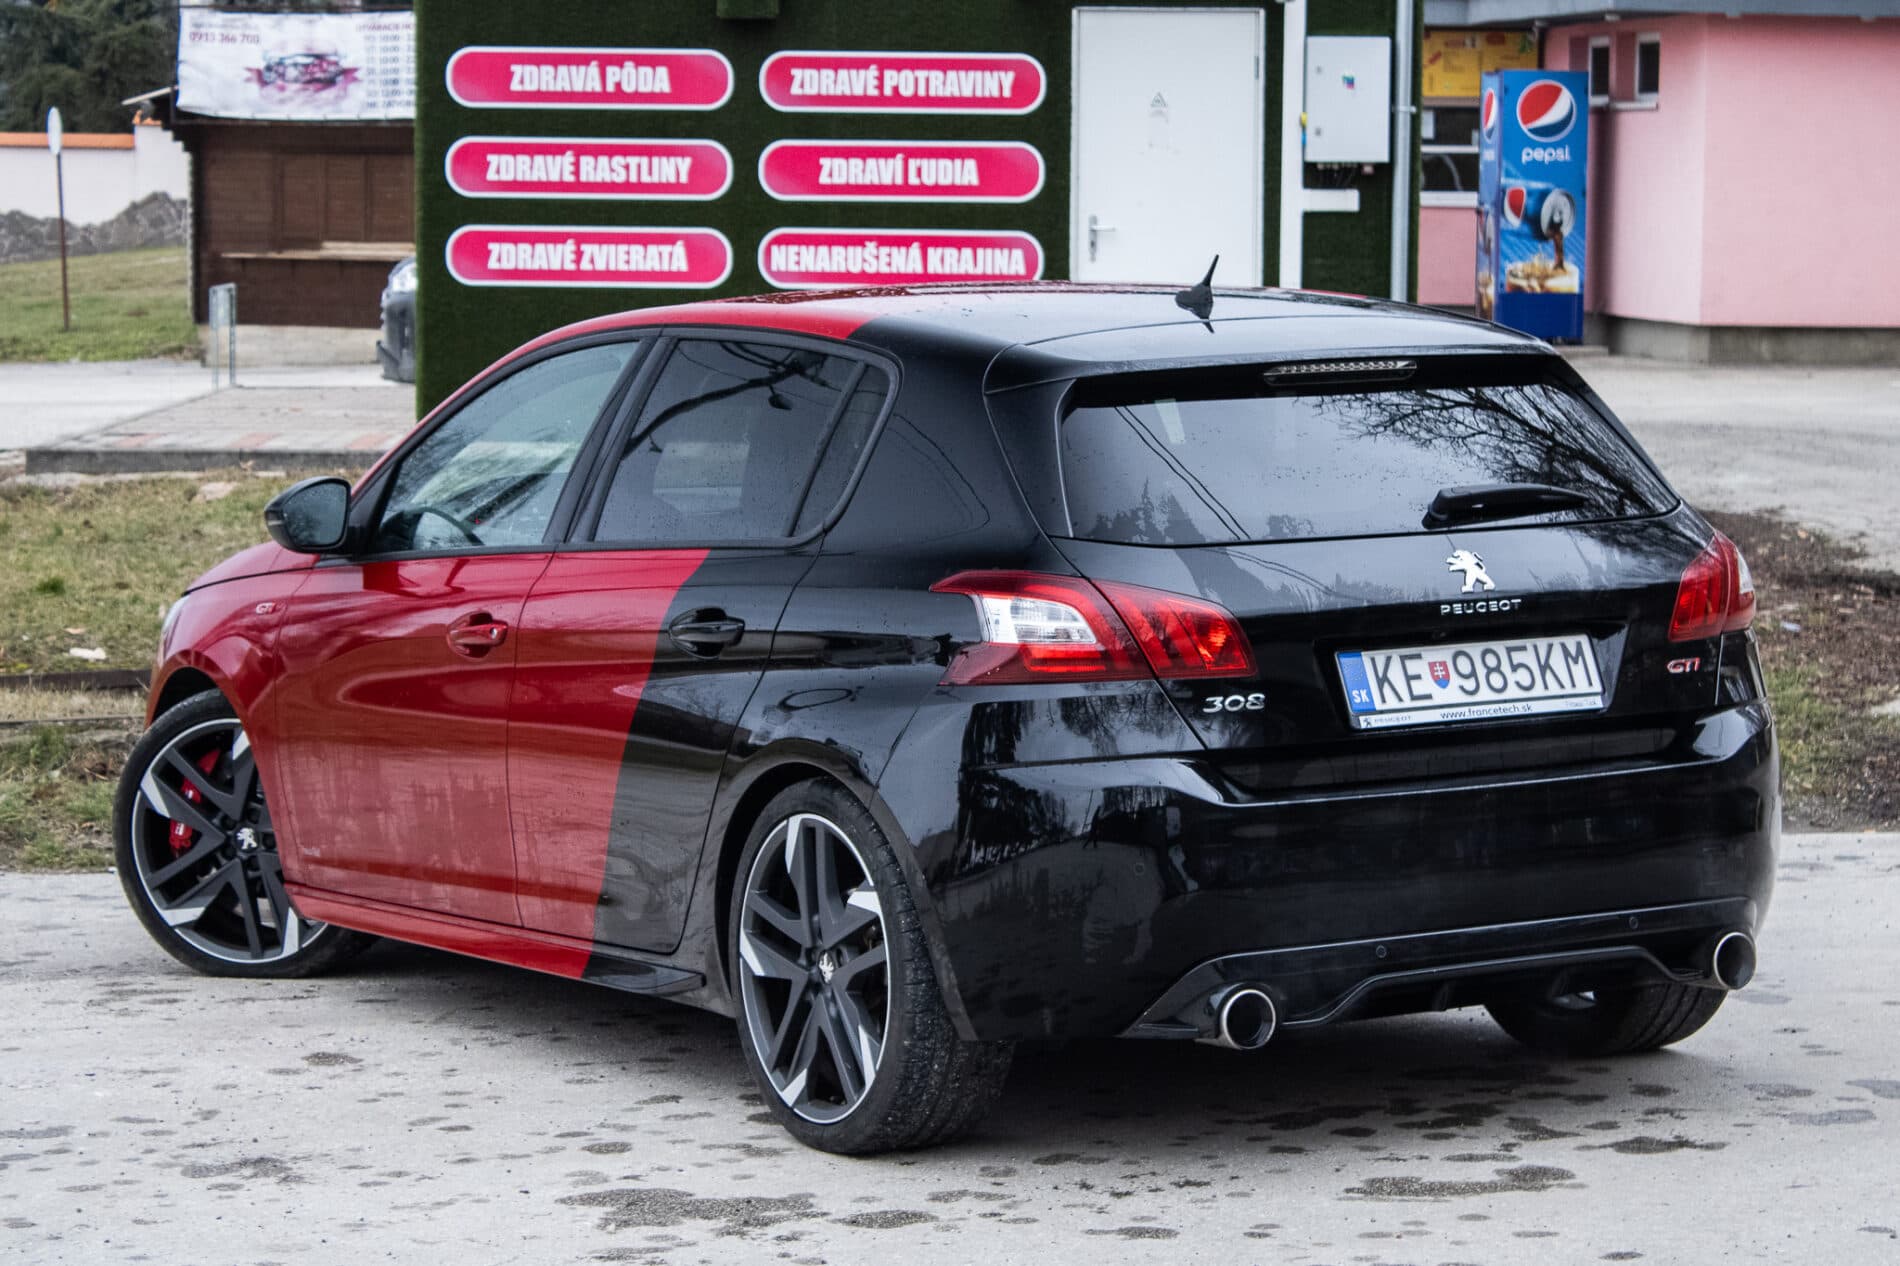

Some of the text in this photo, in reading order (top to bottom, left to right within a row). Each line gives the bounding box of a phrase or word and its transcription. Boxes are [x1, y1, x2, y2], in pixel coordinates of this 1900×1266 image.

[510, 60, 671, 93] ZDRAVÁ PÔDA
[790, 64, 1016, 98] ZDRAVÉ POTRAVINY
[486, 151, 692, 184] ZDRAVÉ RASTLINY
[818, 153, 980, 186] ZDRAVÍ ĽUDIA
[1521, 144, 1571, 165] pepsi
[487, 238, 688, 272] ZDRAVÉ ZVIERATÁ
[770, 241, 1027, 275] NENARUŠENÁ KRAJINA
[1440, 599, 1522, 615] PEUGEOT
[1370, 640, 1594, 705] KE 985KM
[1202, 693, 1265, 713] 308
[1352, 689, 1369, 704] SK
[1440, 703, 1533, 720] www.francetech.sk
